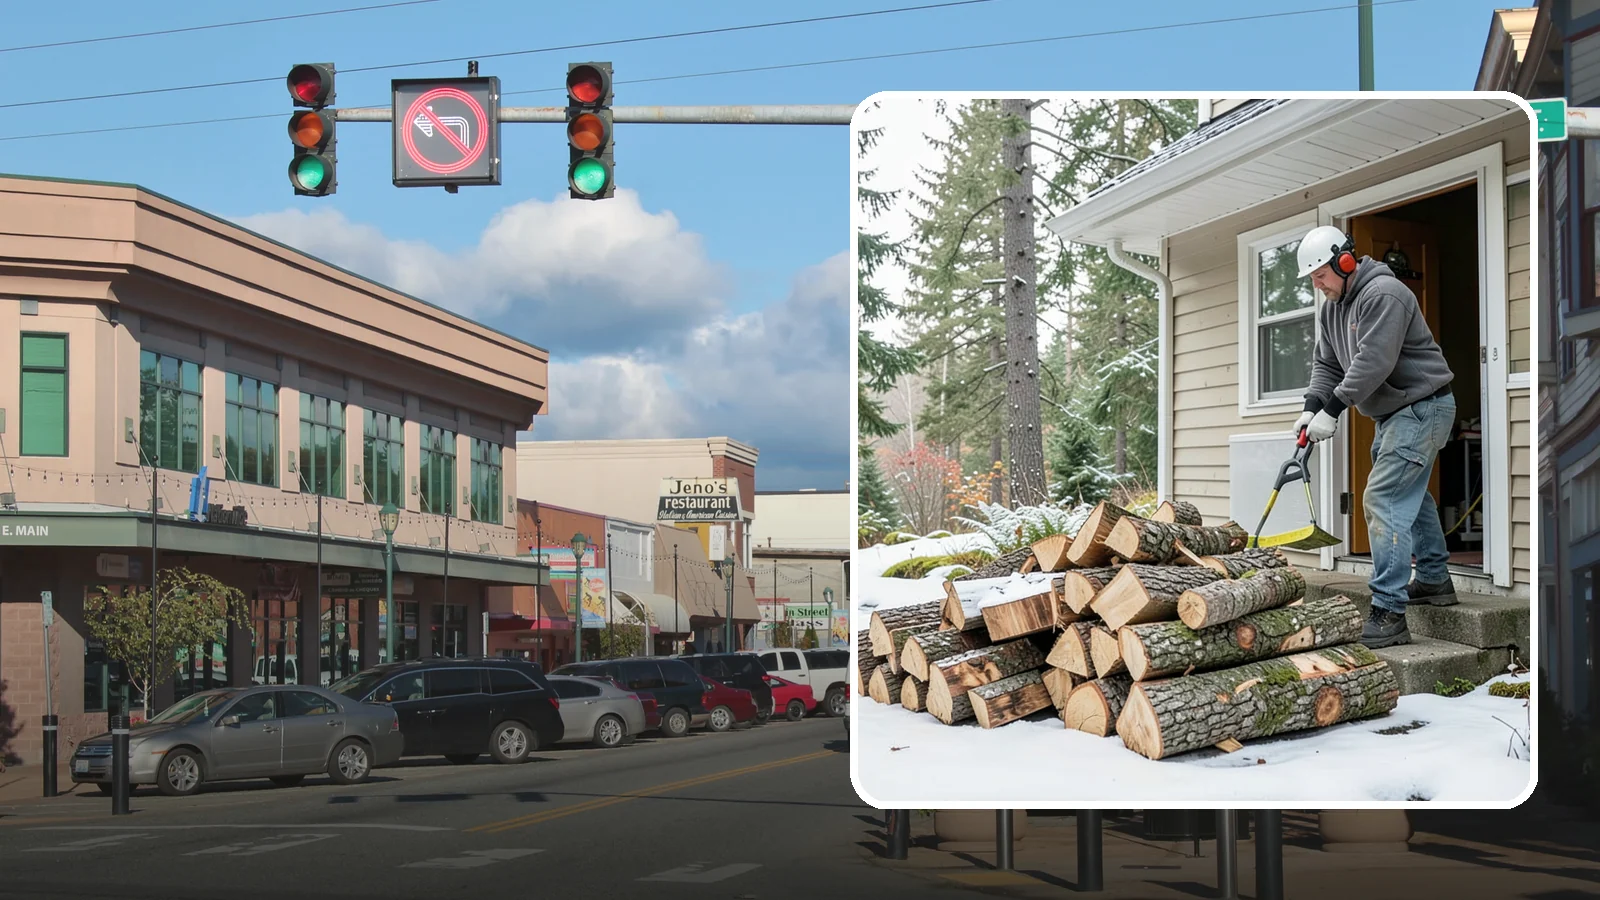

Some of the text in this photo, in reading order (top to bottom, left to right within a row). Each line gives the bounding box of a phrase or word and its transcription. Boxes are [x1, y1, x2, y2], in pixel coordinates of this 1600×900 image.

[669, 480, 727, 494] Jeno's
[665, 497, 730, 509] restaurant
[659, 510, 681, 519] Italian
[686, 510, 714, 519] American
[715, 509, 738, 519] Cuisine
[2, 525, 48, 536] E. MAIN
[798, 608, 828, 616] Street
